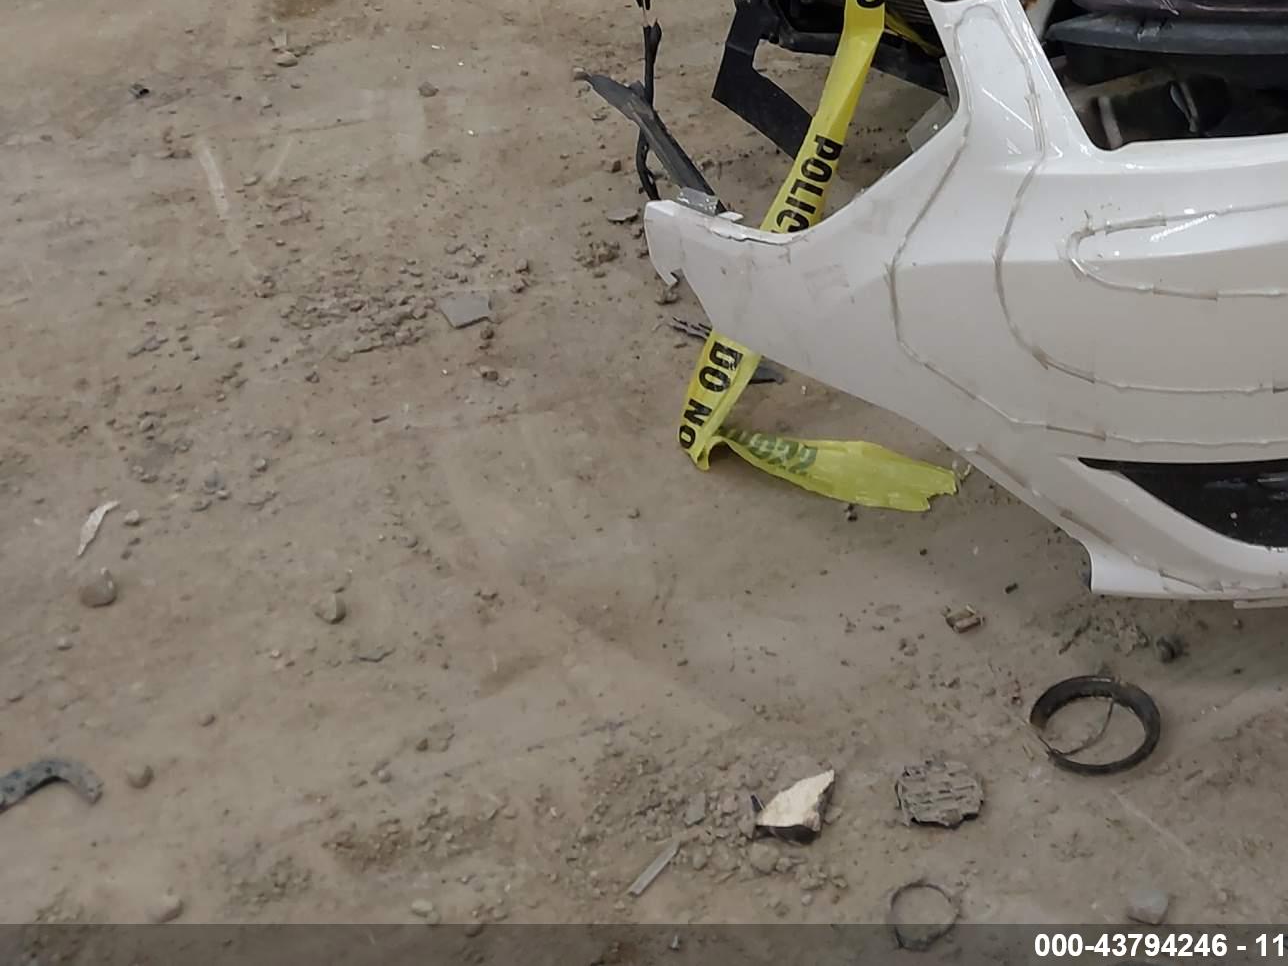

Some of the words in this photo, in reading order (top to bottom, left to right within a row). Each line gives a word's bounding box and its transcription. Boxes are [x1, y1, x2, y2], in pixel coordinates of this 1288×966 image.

[775, 133, 843, 233] POLIC
[699, 340, 744, 394] DO
[678, 398, 712, 449] NO
